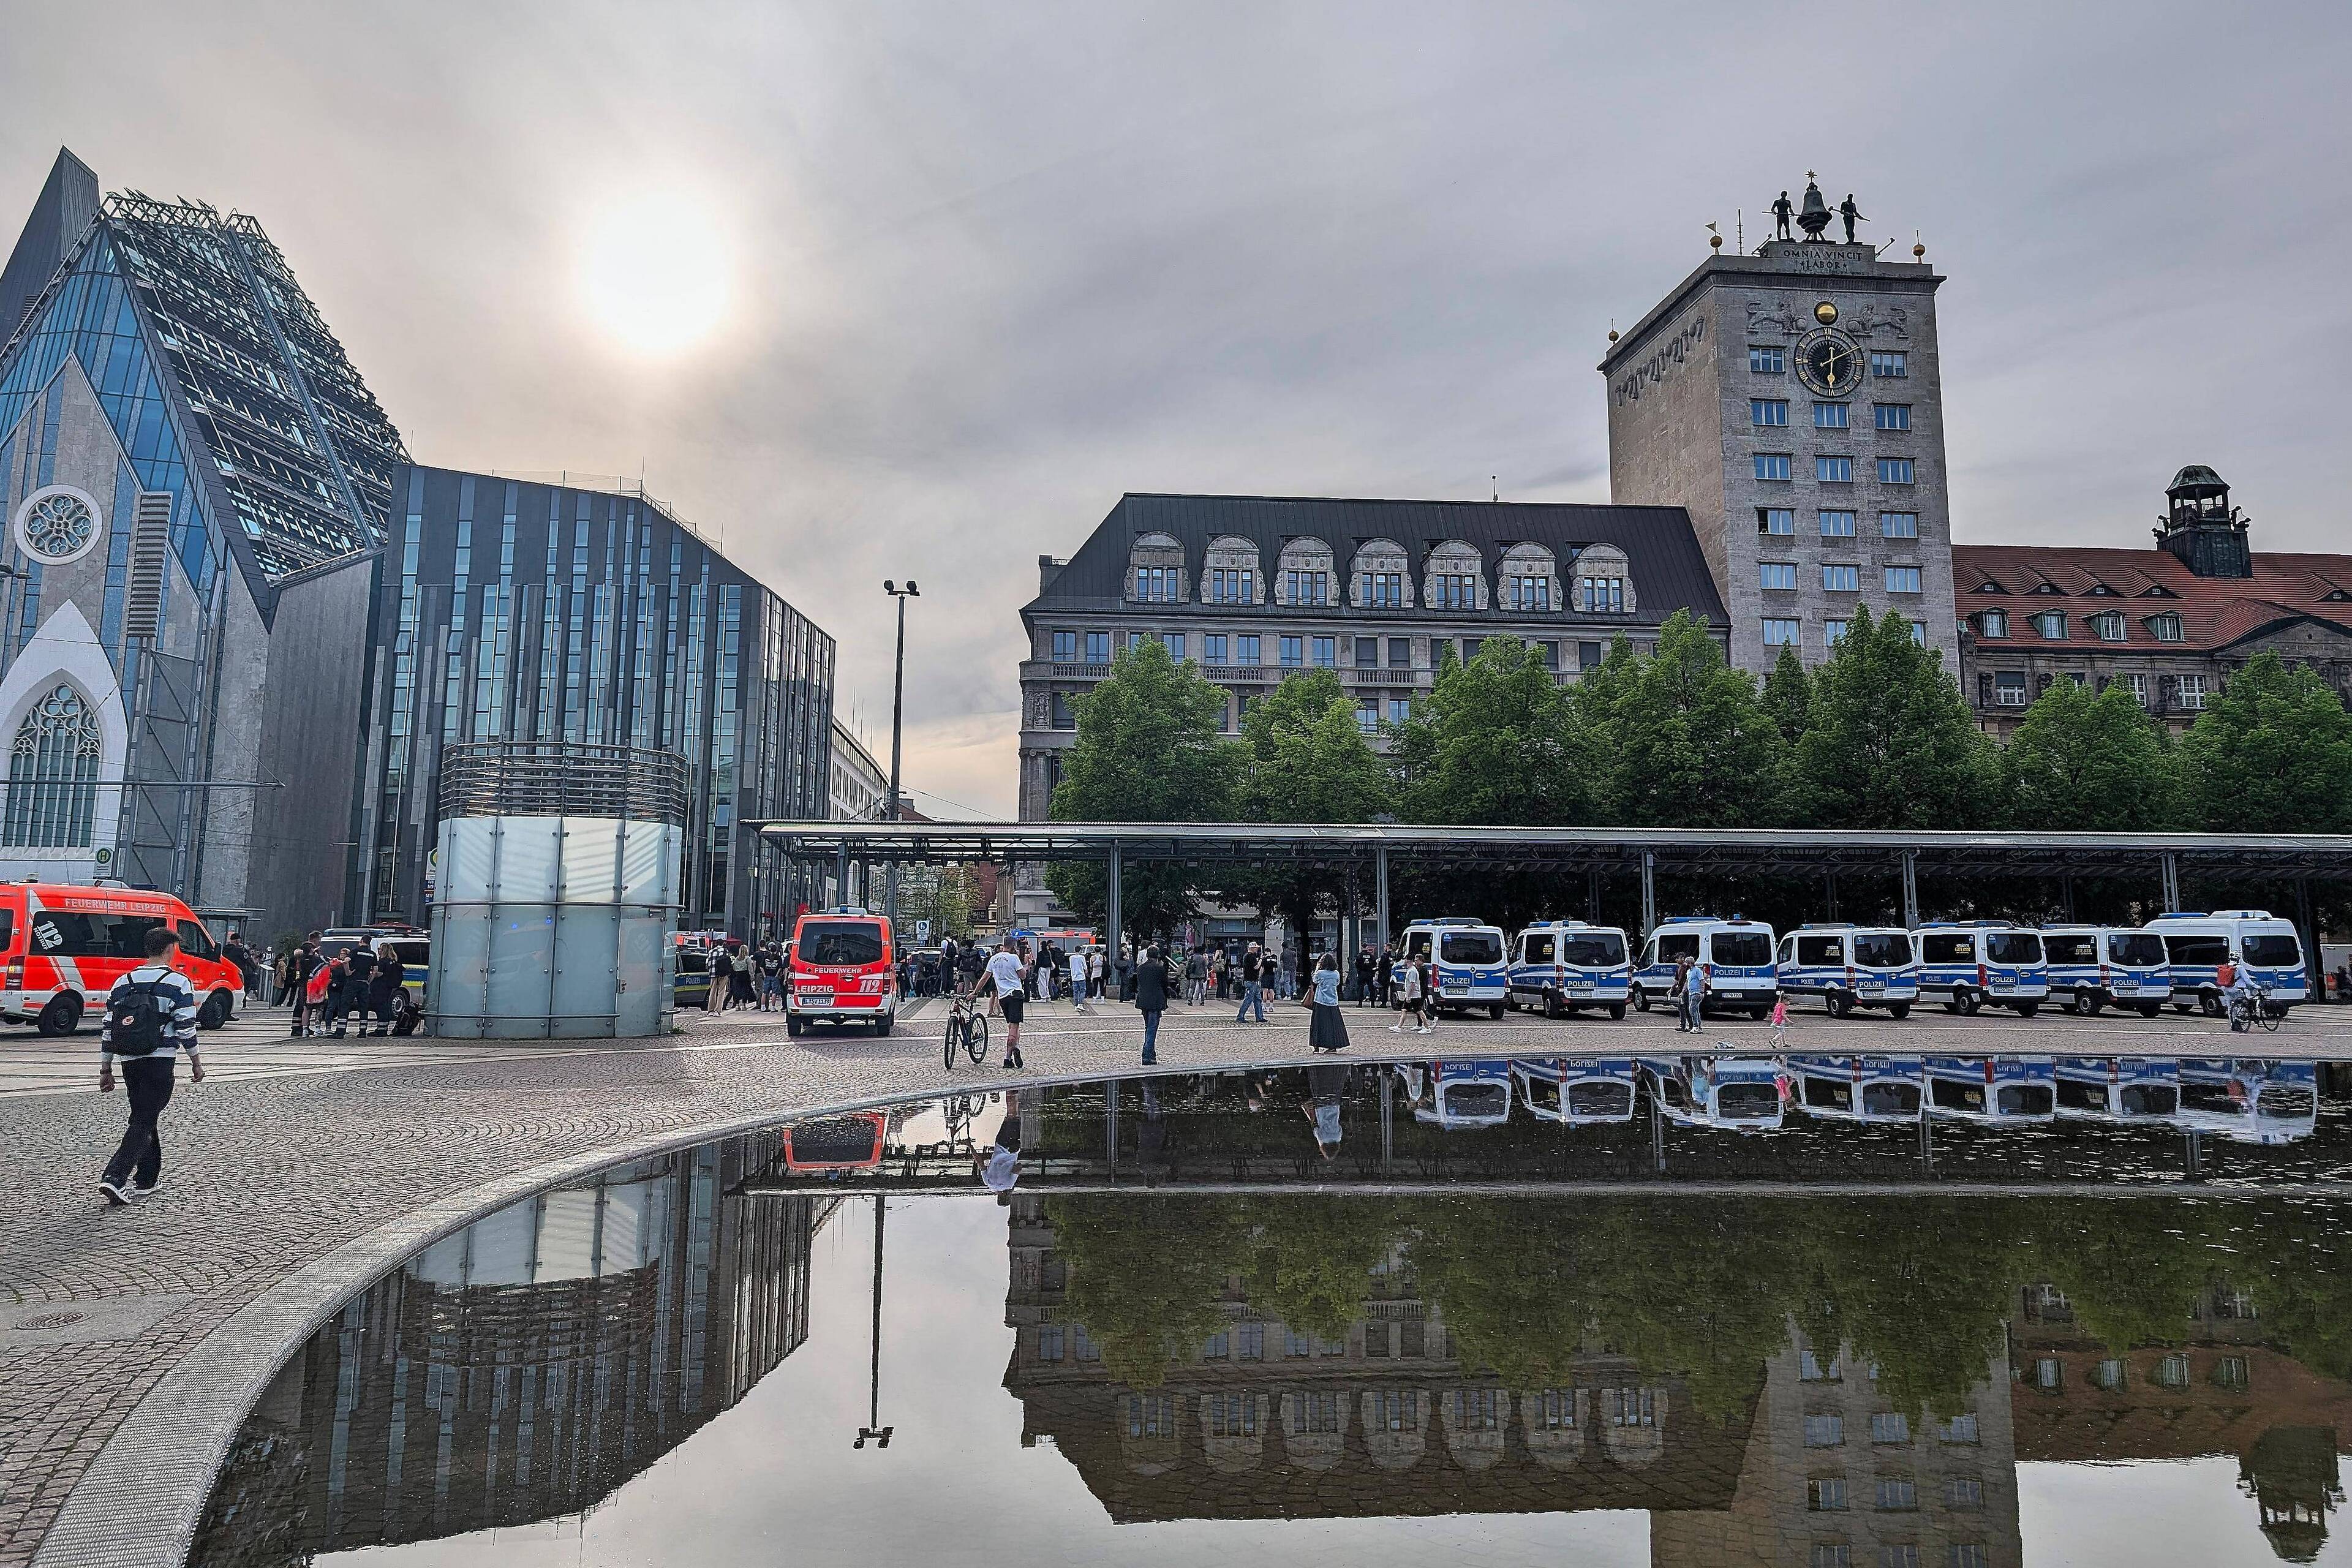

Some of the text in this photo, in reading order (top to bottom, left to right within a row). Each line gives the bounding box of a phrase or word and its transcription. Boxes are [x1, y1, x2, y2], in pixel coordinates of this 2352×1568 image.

[1784, 250, 1862, 262] OMNIA VINCIT
[1809, 331, 1817, 339] XI
[100, 851, 107, 861] H
[65, 898, 167, 912] FEUERWEHR LEIPZIG
[33, 927, 50, 950] NOTRUF
[36, 920, 63, 949] 112
[858, 980, 880, 992] 112
